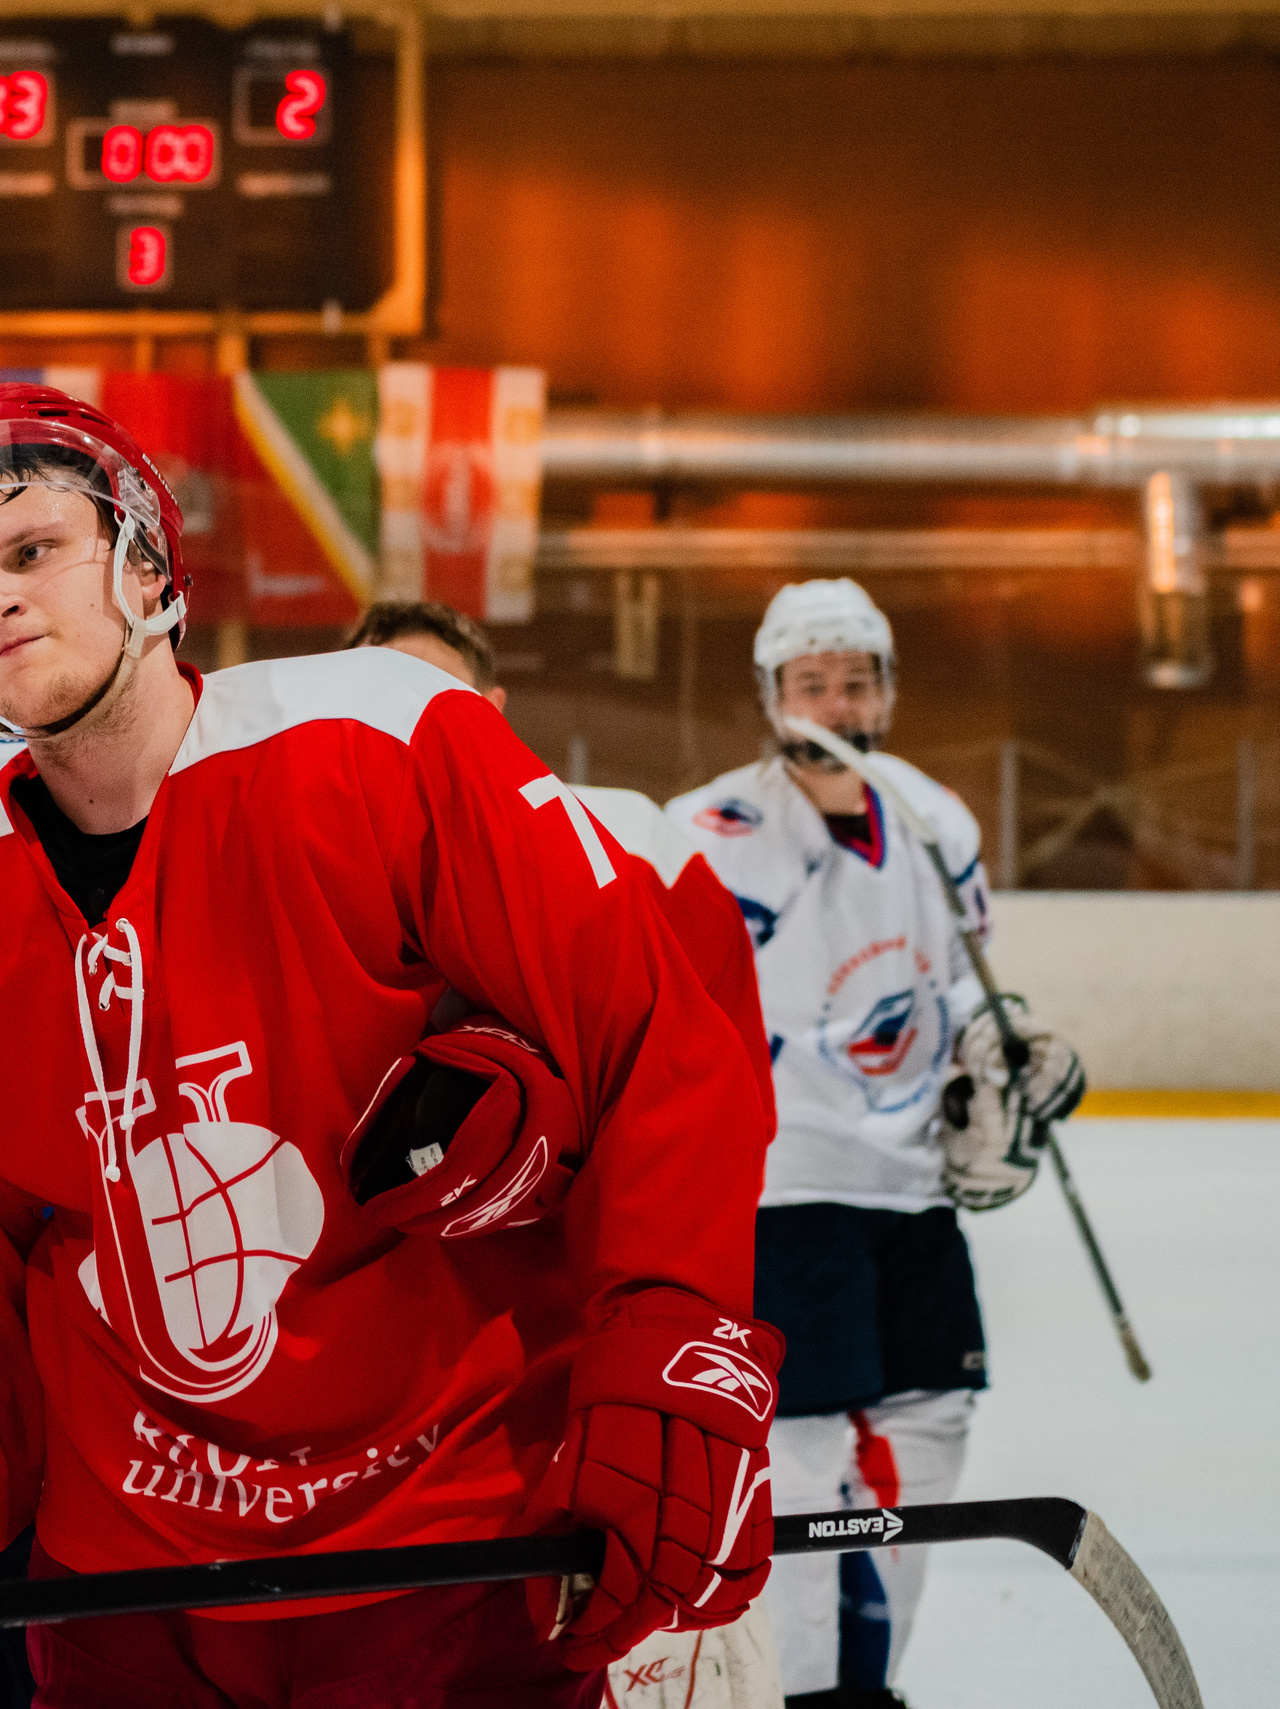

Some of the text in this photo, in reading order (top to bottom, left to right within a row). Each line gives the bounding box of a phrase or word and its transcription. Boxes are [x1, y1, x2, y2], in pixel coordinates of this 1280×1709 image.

[276, 69, 326, 140] 2
[128, 226, 166, 285] 3
[517, 772, 618, 890] 7
[712, 1316, 753, 1350] 2K
[807, 1516, 885, 1539] EASTON
